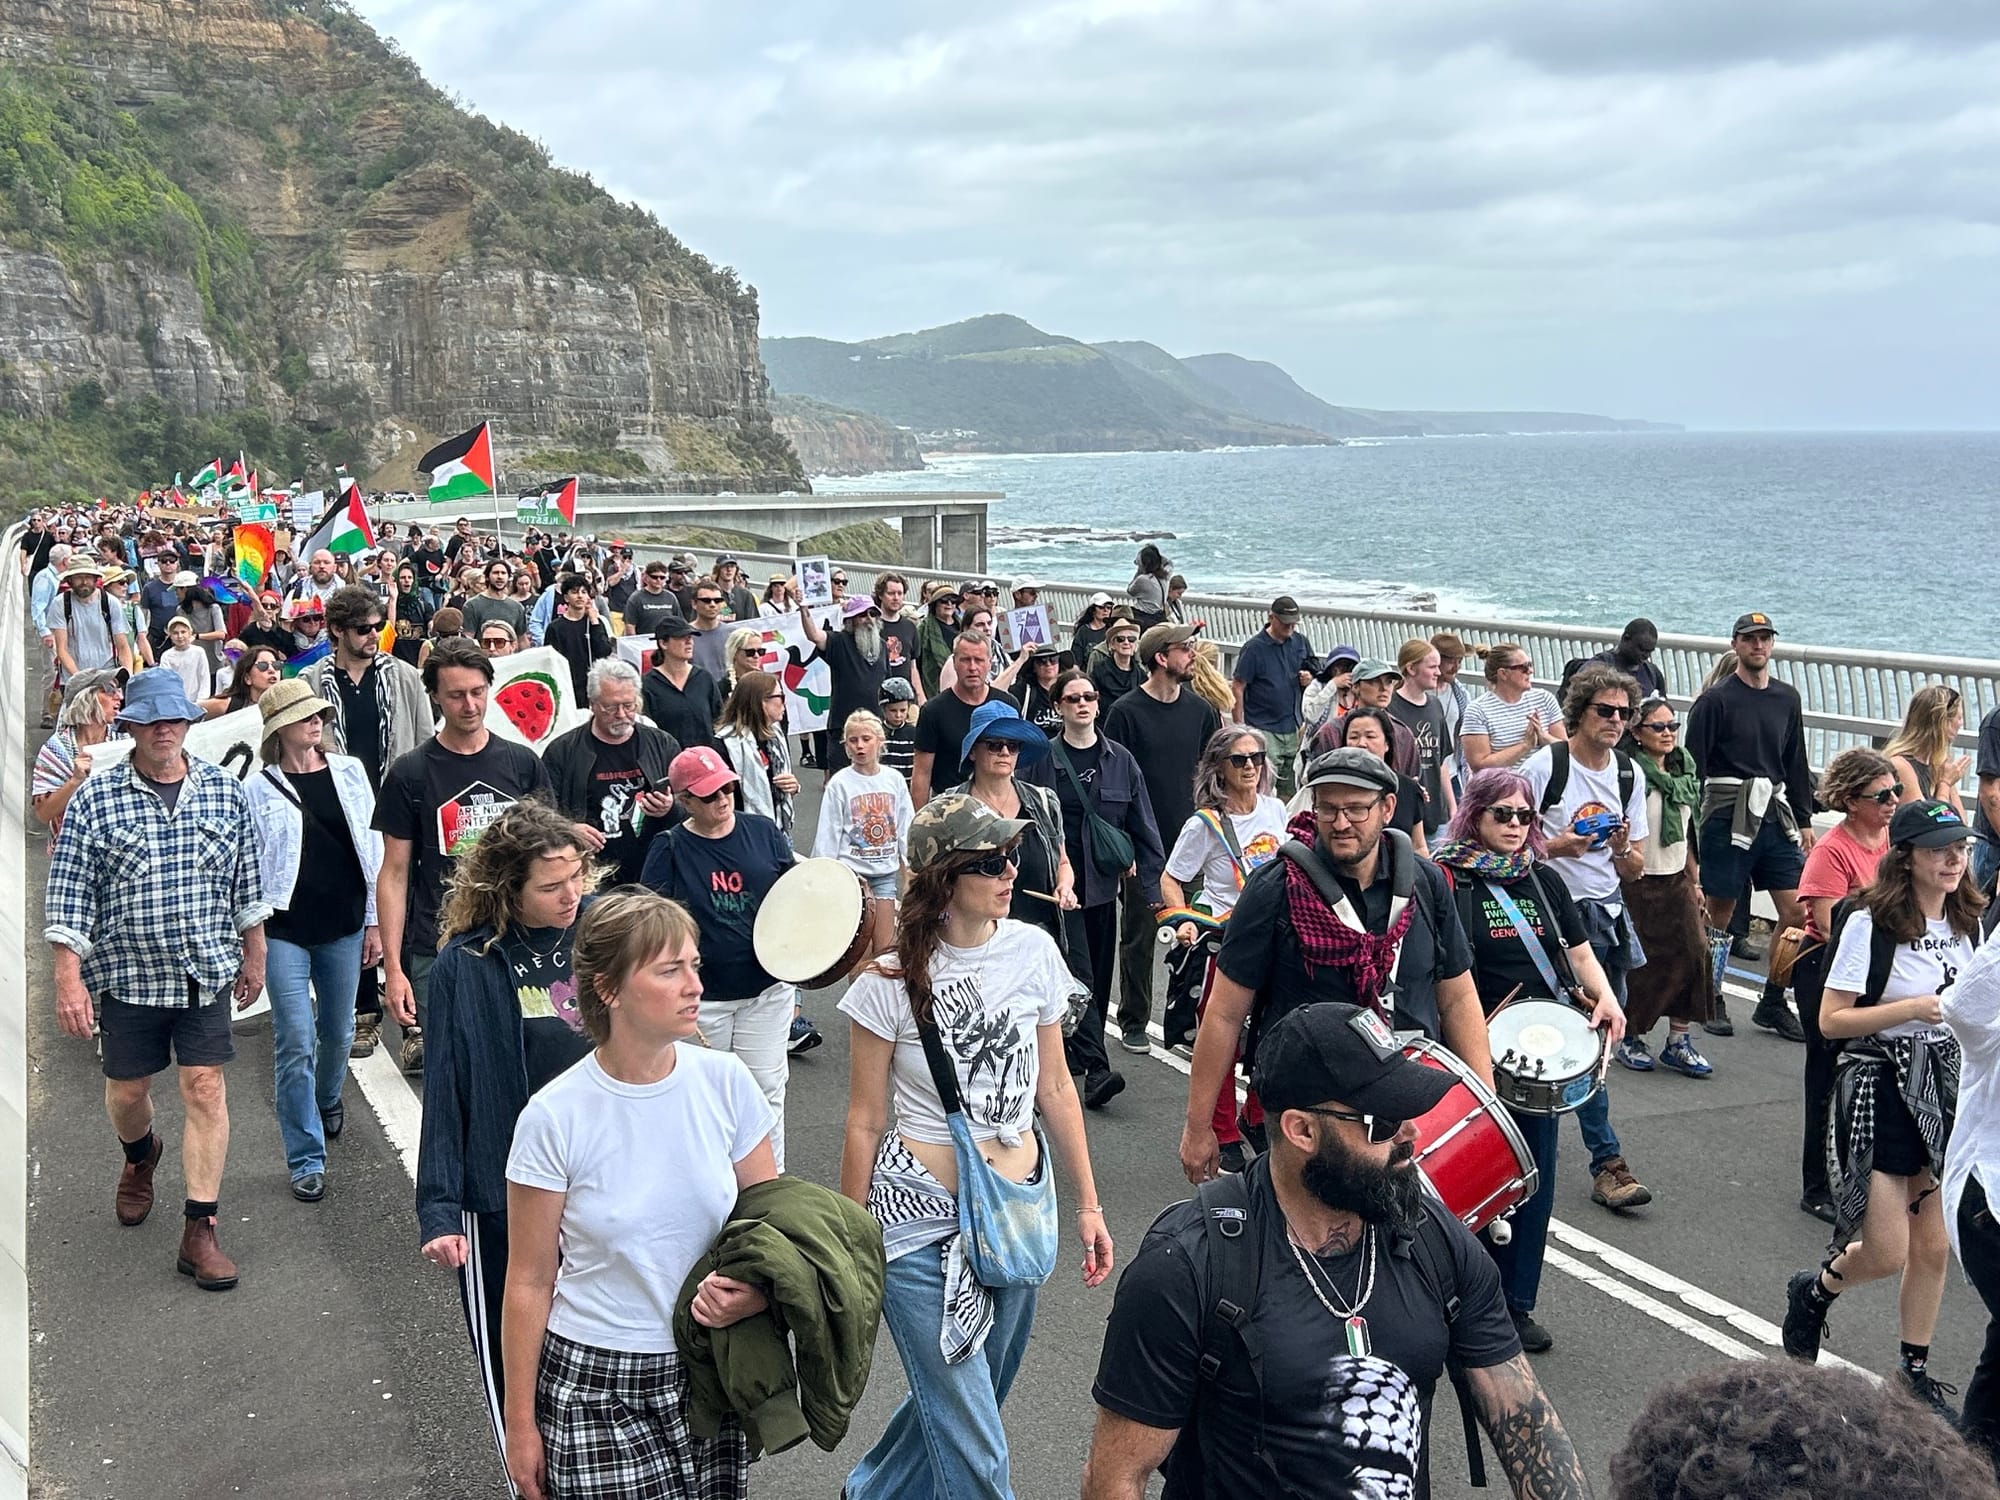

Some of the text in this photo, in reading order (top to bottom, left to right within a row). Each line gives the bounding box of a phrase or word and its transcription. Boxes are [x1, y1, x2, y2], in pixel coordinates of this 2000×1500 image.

[470, 792, 495, 806] YOU
[458, 807, 480, 817] ARE
[457, 816, 495, 828] ENTER
[711, 870, 743, 893] NO
[710, 891, 757, 912] WAR
[1482, 899, 1535, 910] REERS
[1489, 908, 1538, 919] WRRS
[1489, 917, 1535, 928] AGAT
[1490, 926, 1546, 939] GENODE
